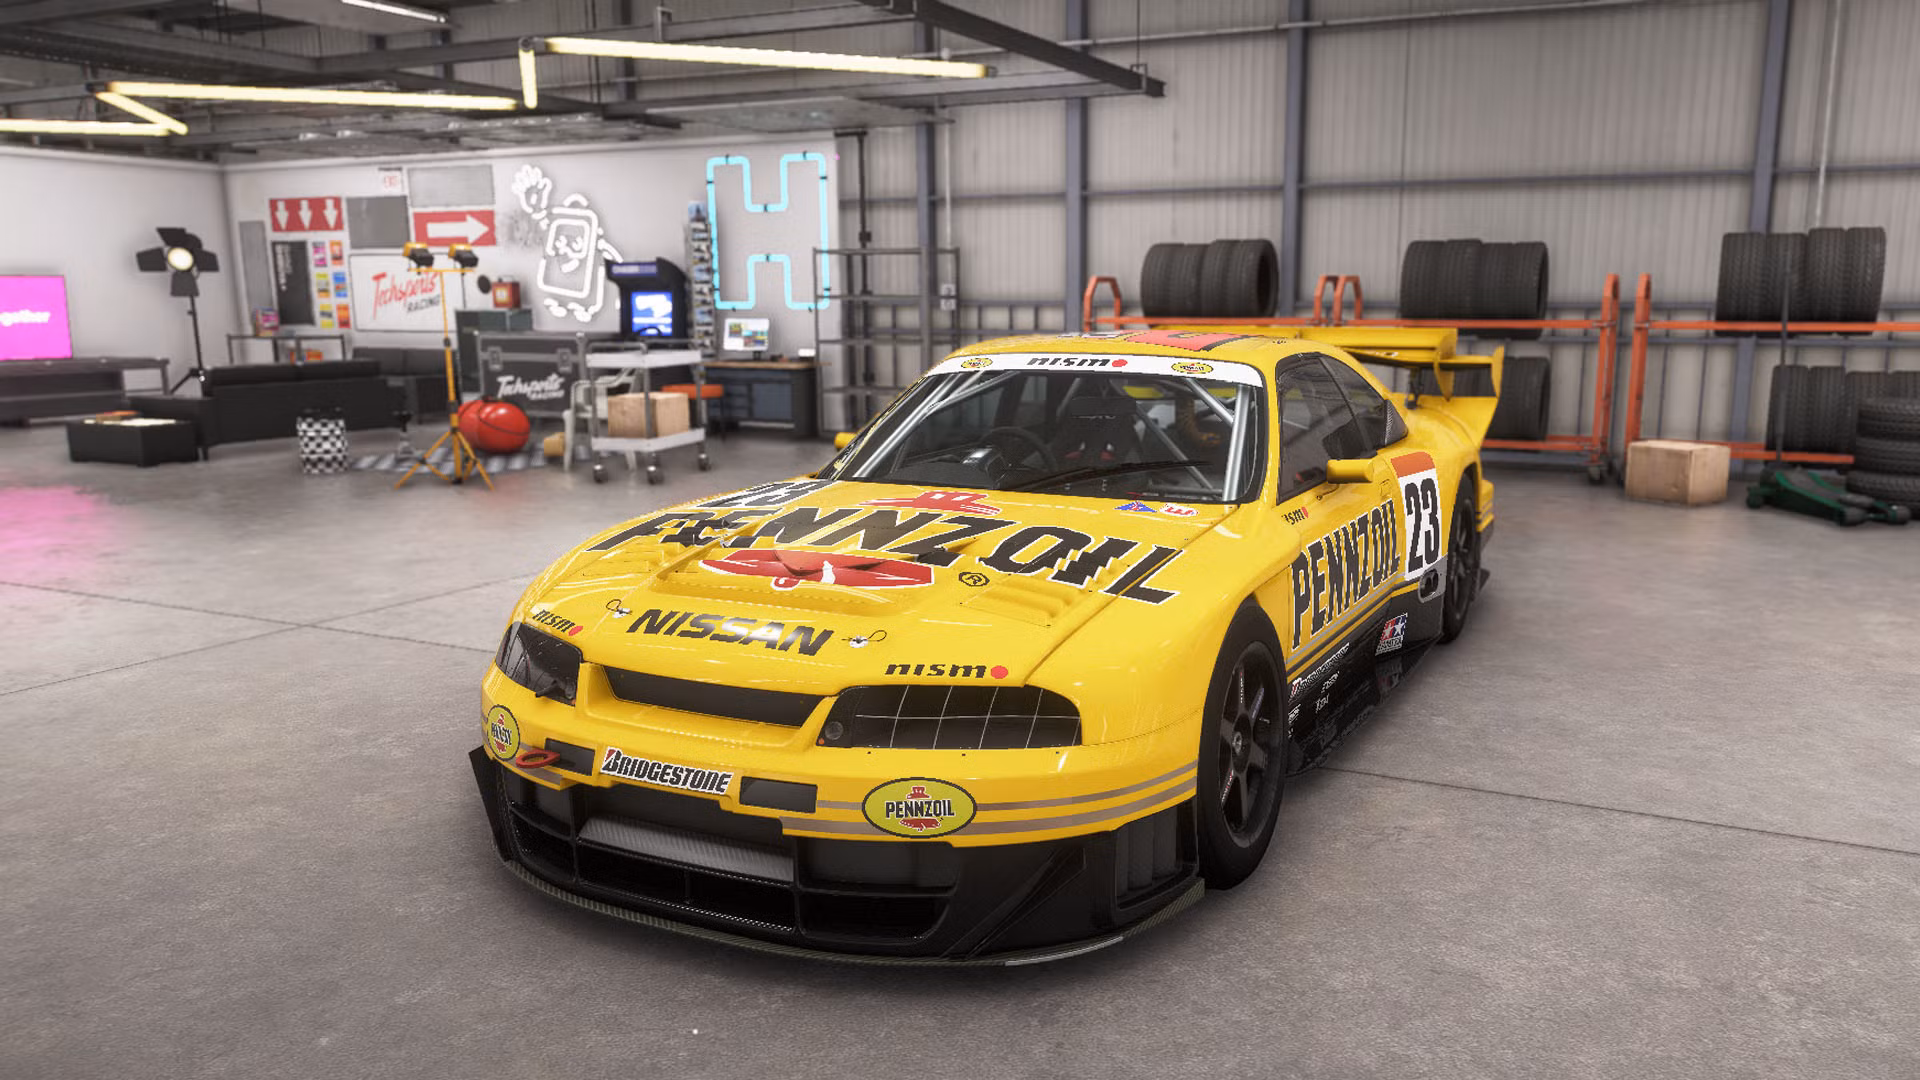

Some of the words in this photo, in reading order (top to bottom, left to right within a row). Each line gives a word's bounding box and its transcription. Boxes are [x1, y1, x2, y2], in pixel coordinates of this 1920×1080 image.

[585, 506, 1185, 605] PENNZOIL
[1404, 478, 1440, 574] 23
[1291, 498, 1401, 652] PENNZOIL
[626, 609, 833, 656] NISSAN
[602, 748, 732, 794] BRIDGESTONE
[885, 800, 955, 818] PENNZOIL
